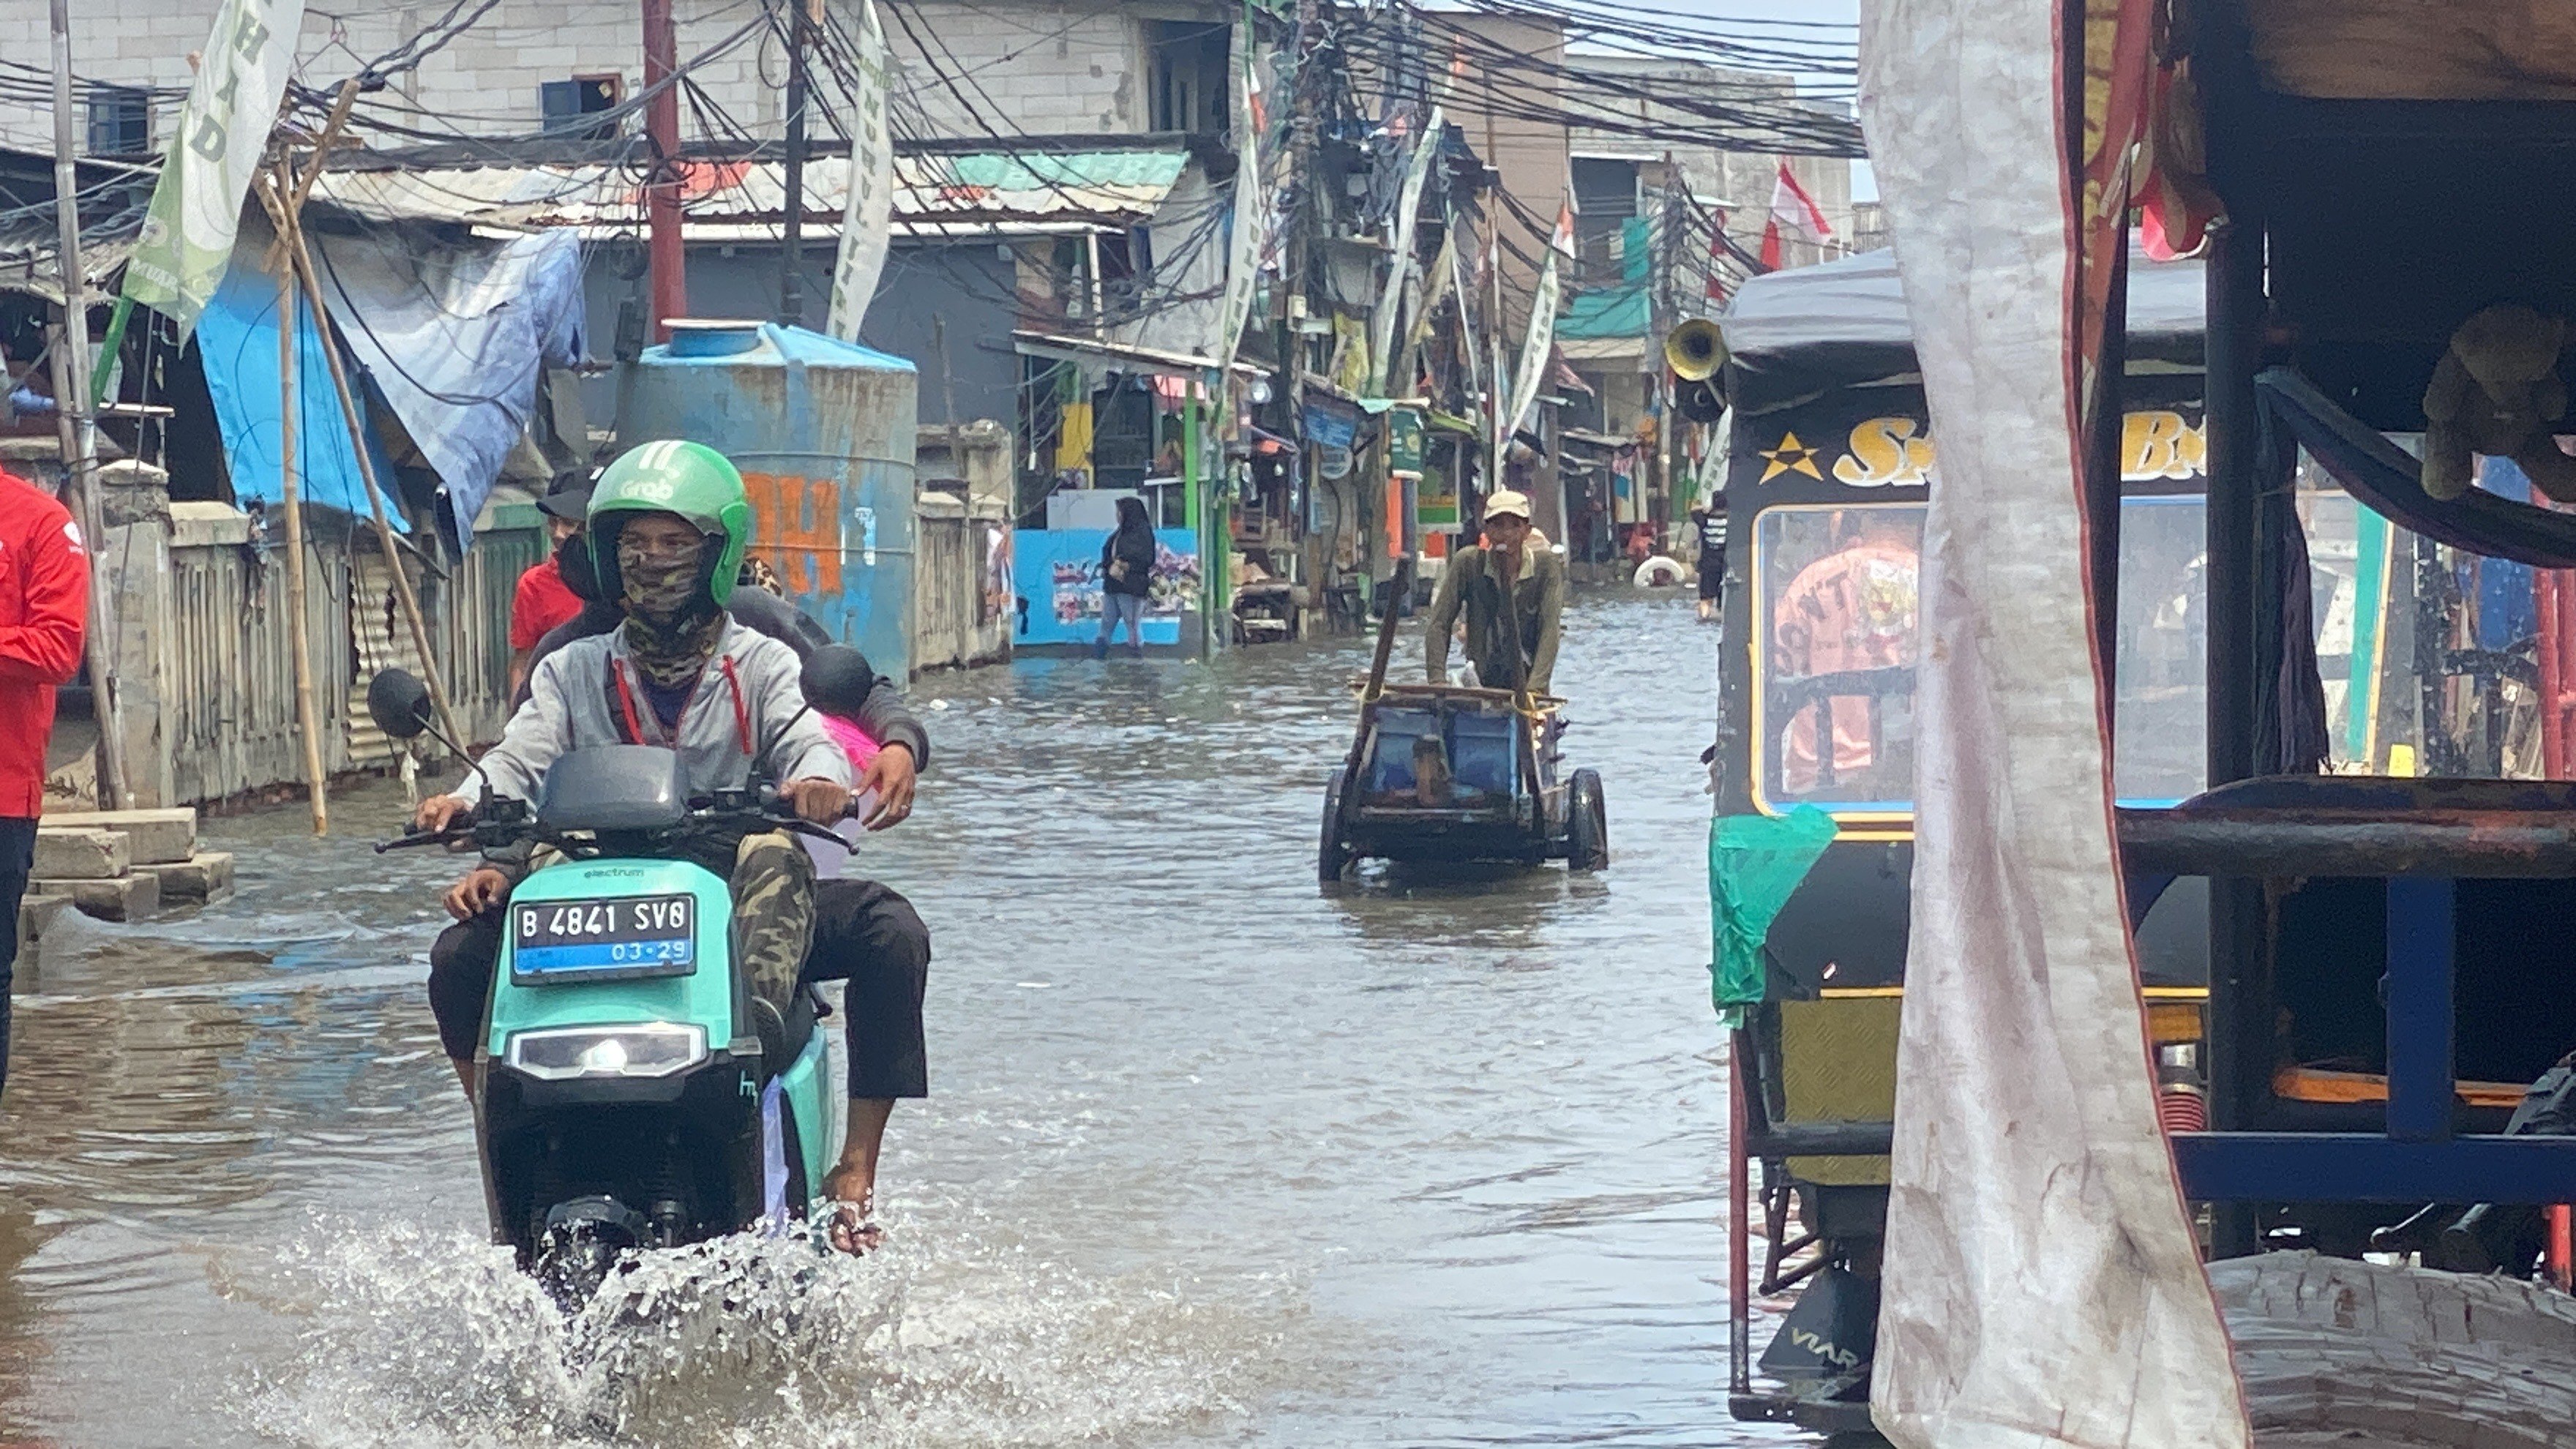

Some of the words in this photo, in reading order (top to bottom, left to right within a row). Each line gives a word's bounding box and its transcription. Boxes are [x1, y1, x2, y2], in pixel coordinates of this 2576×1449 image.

[621, 478, 674, 501] Grab
[583, 867, 645, 878] electrum
[522, 910, 538, 937] B
[548, 905, 616, 936] 4841
